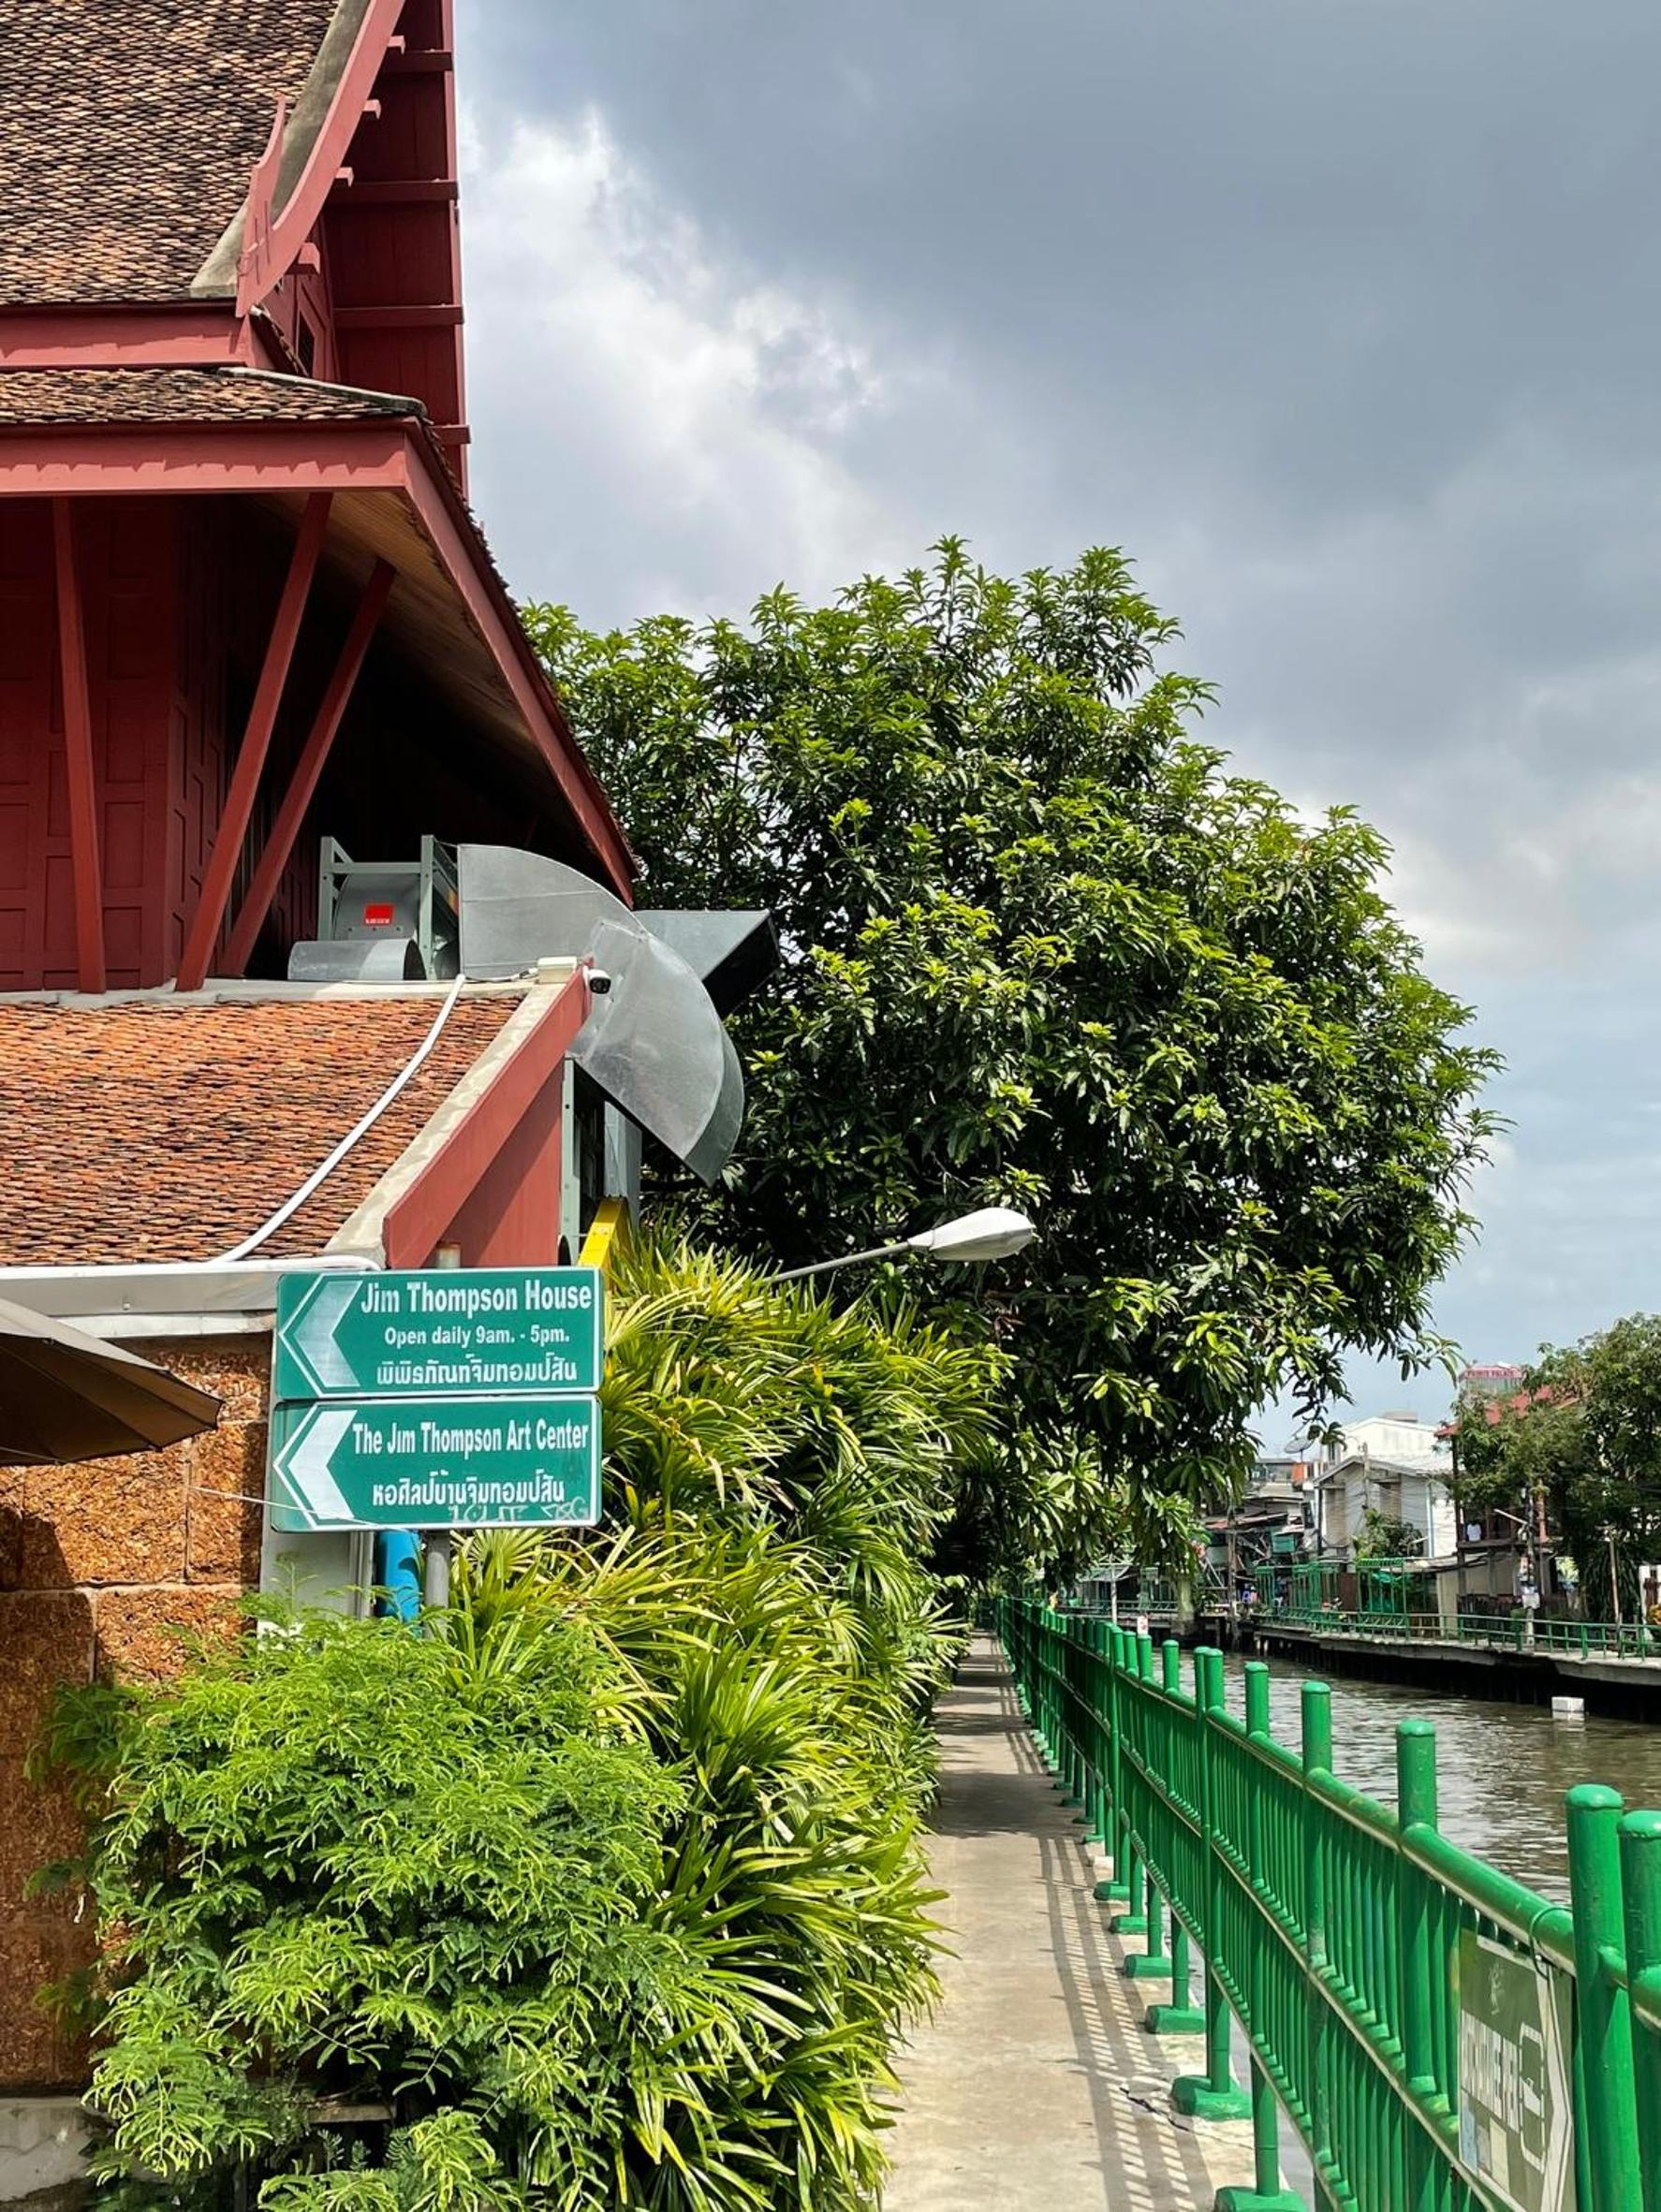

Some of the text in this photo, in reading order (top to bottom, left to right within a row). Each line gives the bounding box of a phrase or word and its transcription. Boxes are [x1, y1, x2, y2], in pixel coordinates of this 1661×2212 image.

[360, 1279, 593, 1320] Jim Thompson House
[385, 1326, 428, 1349] Open
[432, 1325, 472, 1347] daily
[476, 1326, 516, 1344] 9am.
[530, 1324, 570, 1347] 5pm.
[352, 1418, 589, 1460] The Jim Thompson Art Center
